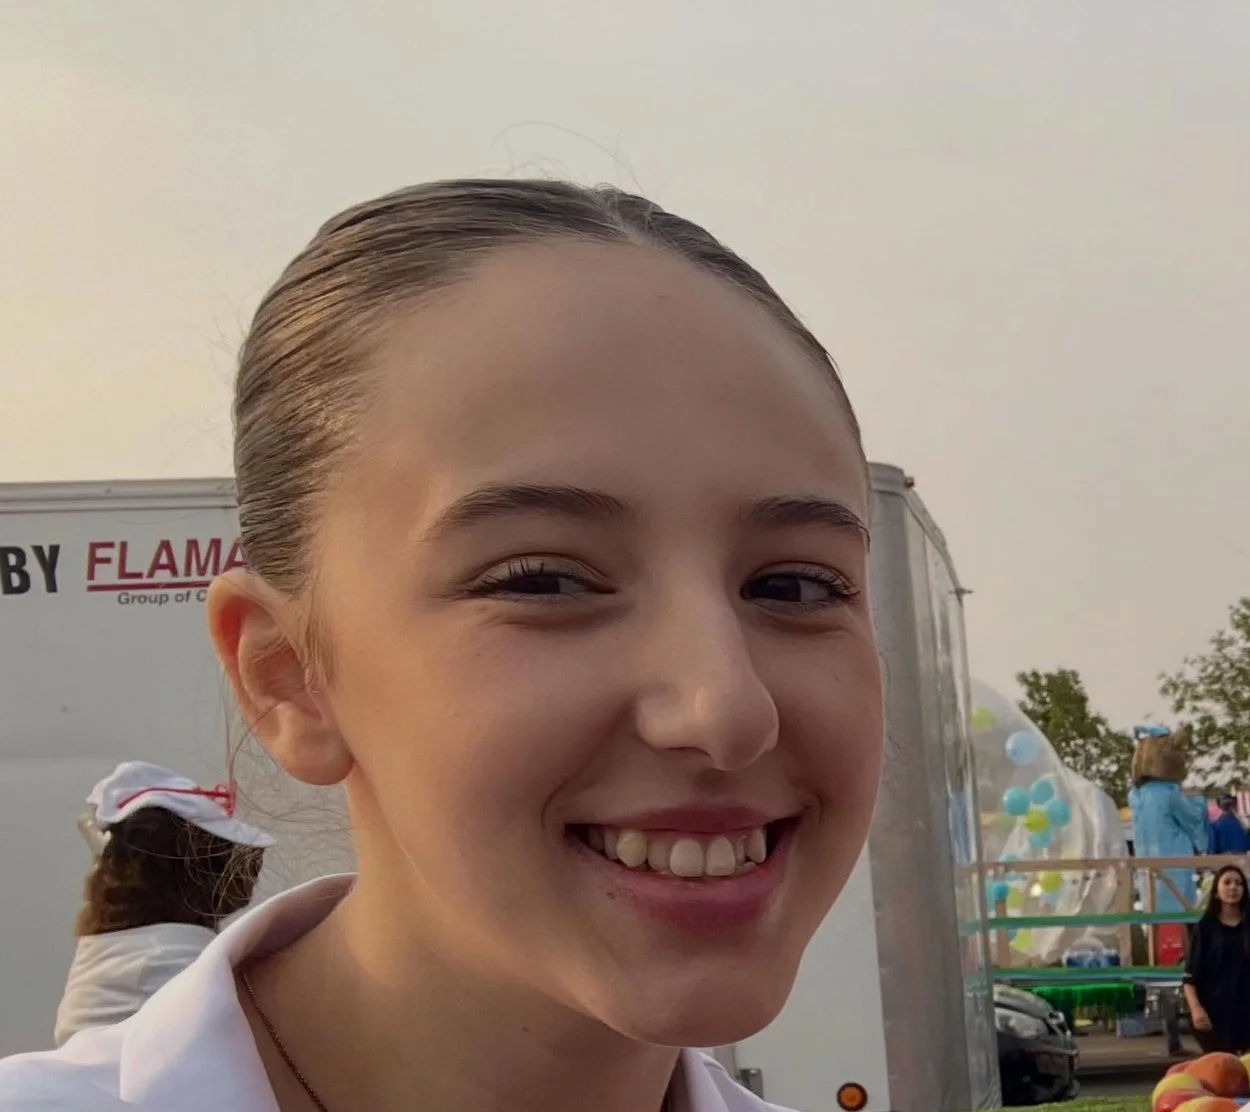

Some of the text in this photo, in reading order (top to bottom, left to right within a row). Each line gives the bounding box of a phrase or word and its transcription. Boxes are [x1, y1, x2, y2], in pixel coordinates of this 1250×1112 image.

[0, 543, 61, 596] BY
[117, 591, 170, 606] Group
[175, 589, 192, 603] of
